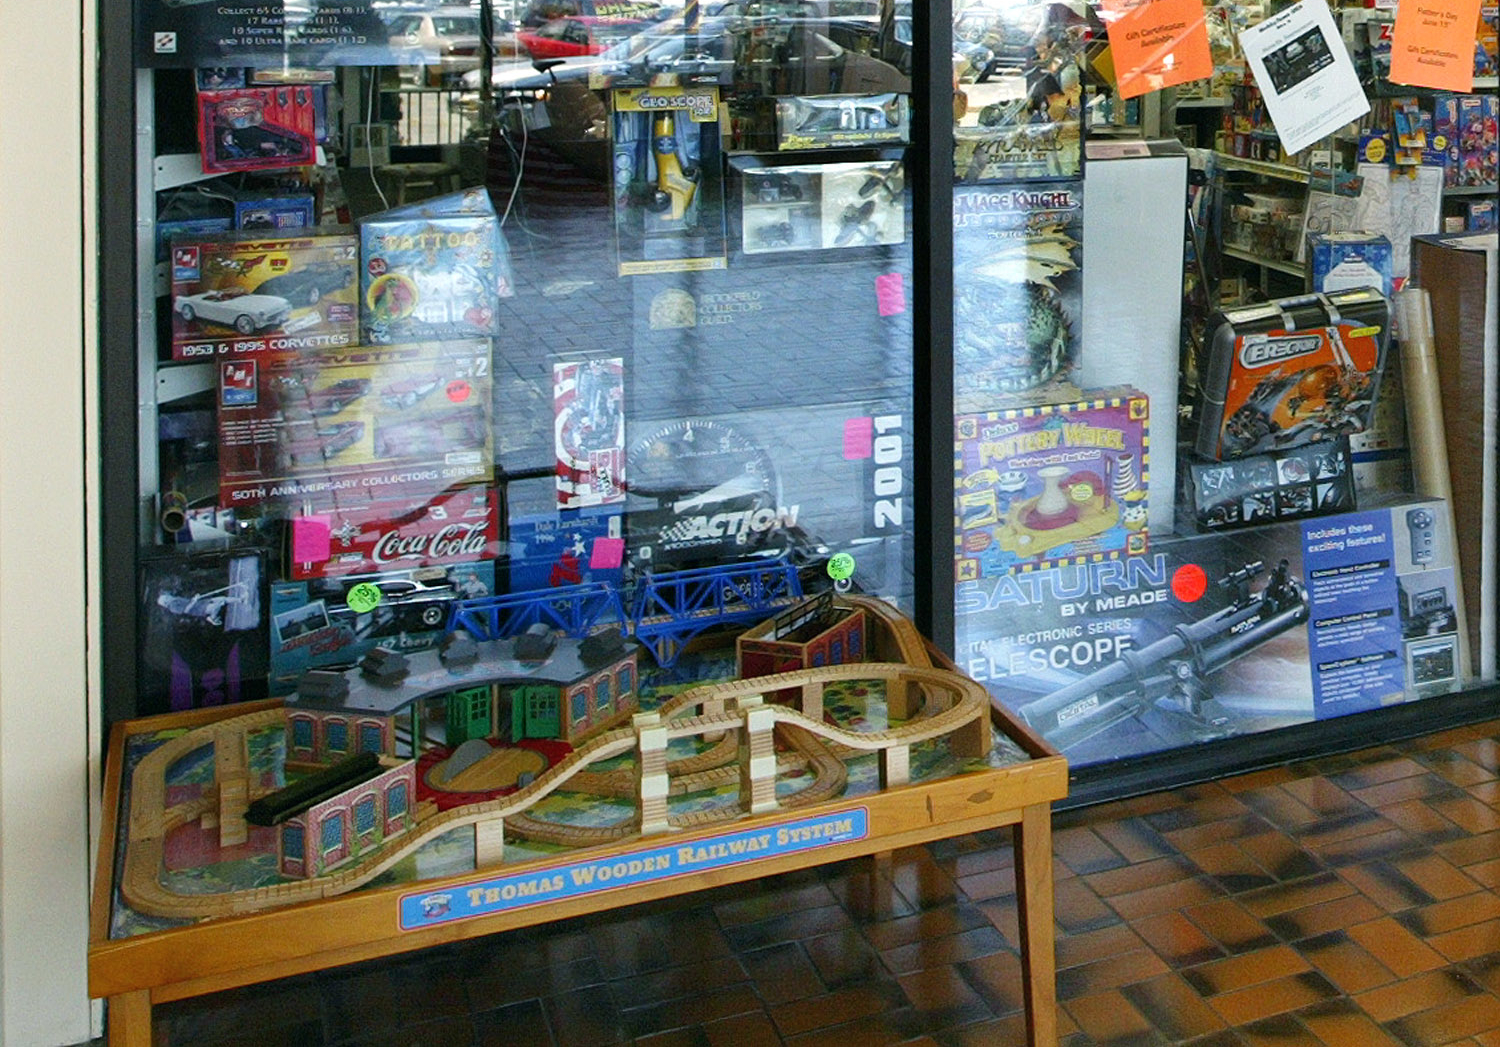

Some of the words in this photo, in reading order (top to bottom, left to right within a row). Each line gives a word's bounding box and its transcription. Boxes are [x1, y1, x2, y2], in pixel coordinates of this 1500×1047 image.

[1011, 190, 1072, 208] KNIGHT
[385, 232, 478, 251] TATTOO
[269, 333, 350, 351] CORVETTES
[476, 357, 487, 377] 2
[270, 478, 358, 498] ANNIVERSARY
[361, 469, 439, 487] COLLECTORS
[873, 413, 902, 529] 2001
[687, 505, 800, 540] ACTION
[1306, 527, 1347, 541] Includes
[1347, 522, 1375, 534] these
[1307, 538, 1345, 554] exciting
[1345, 532, 1387, 548] features!
[954, 553, 1168, 614] SATURN
[1061, 601, 1089, 617] BY
[1095, 589, 1168, 612] MEADE
[399, 632, 434, 650] Chevy
[1001, 624, 1083, 649] ELECTRONIC
[1087, 617, 1132, 636] SERIES
[467, 876, 565, 908] THOMAS
[571, 854, 671, 887] WOODEN
[676, 835, 771, 867] RAILWAY
[776, 817, 854, 847] SYSTEM
